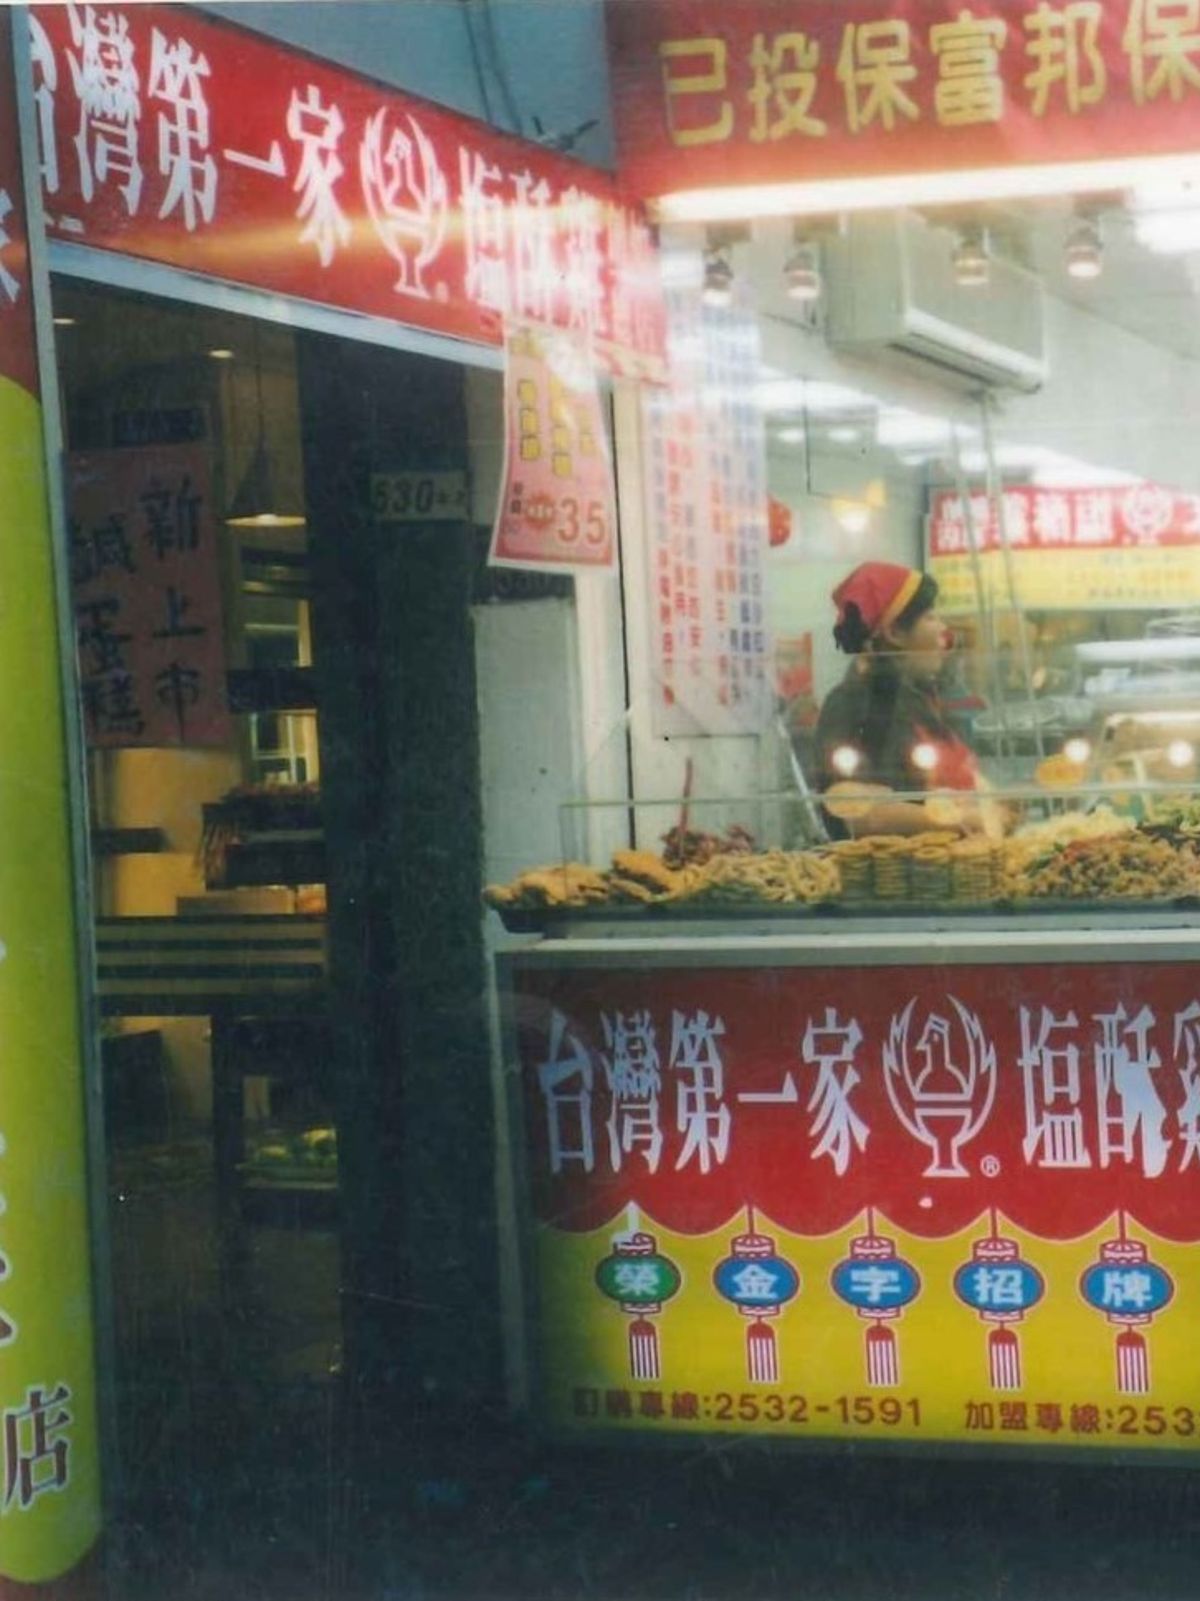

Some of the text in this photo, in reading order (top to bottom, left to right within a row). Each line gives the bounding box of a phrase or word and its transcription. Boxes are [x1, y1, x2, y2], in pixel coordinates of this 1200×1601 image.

[557, 497, 606, 545] 35
[538, 1006, 871, 1177] 台灣第一家
[731, 1263, 778, 1299] 金
[973, 1266, 1024, 1305] 招
[1101, 1272, 1152, 1308] 牌
[4, 1387, 70, 1506] 店
